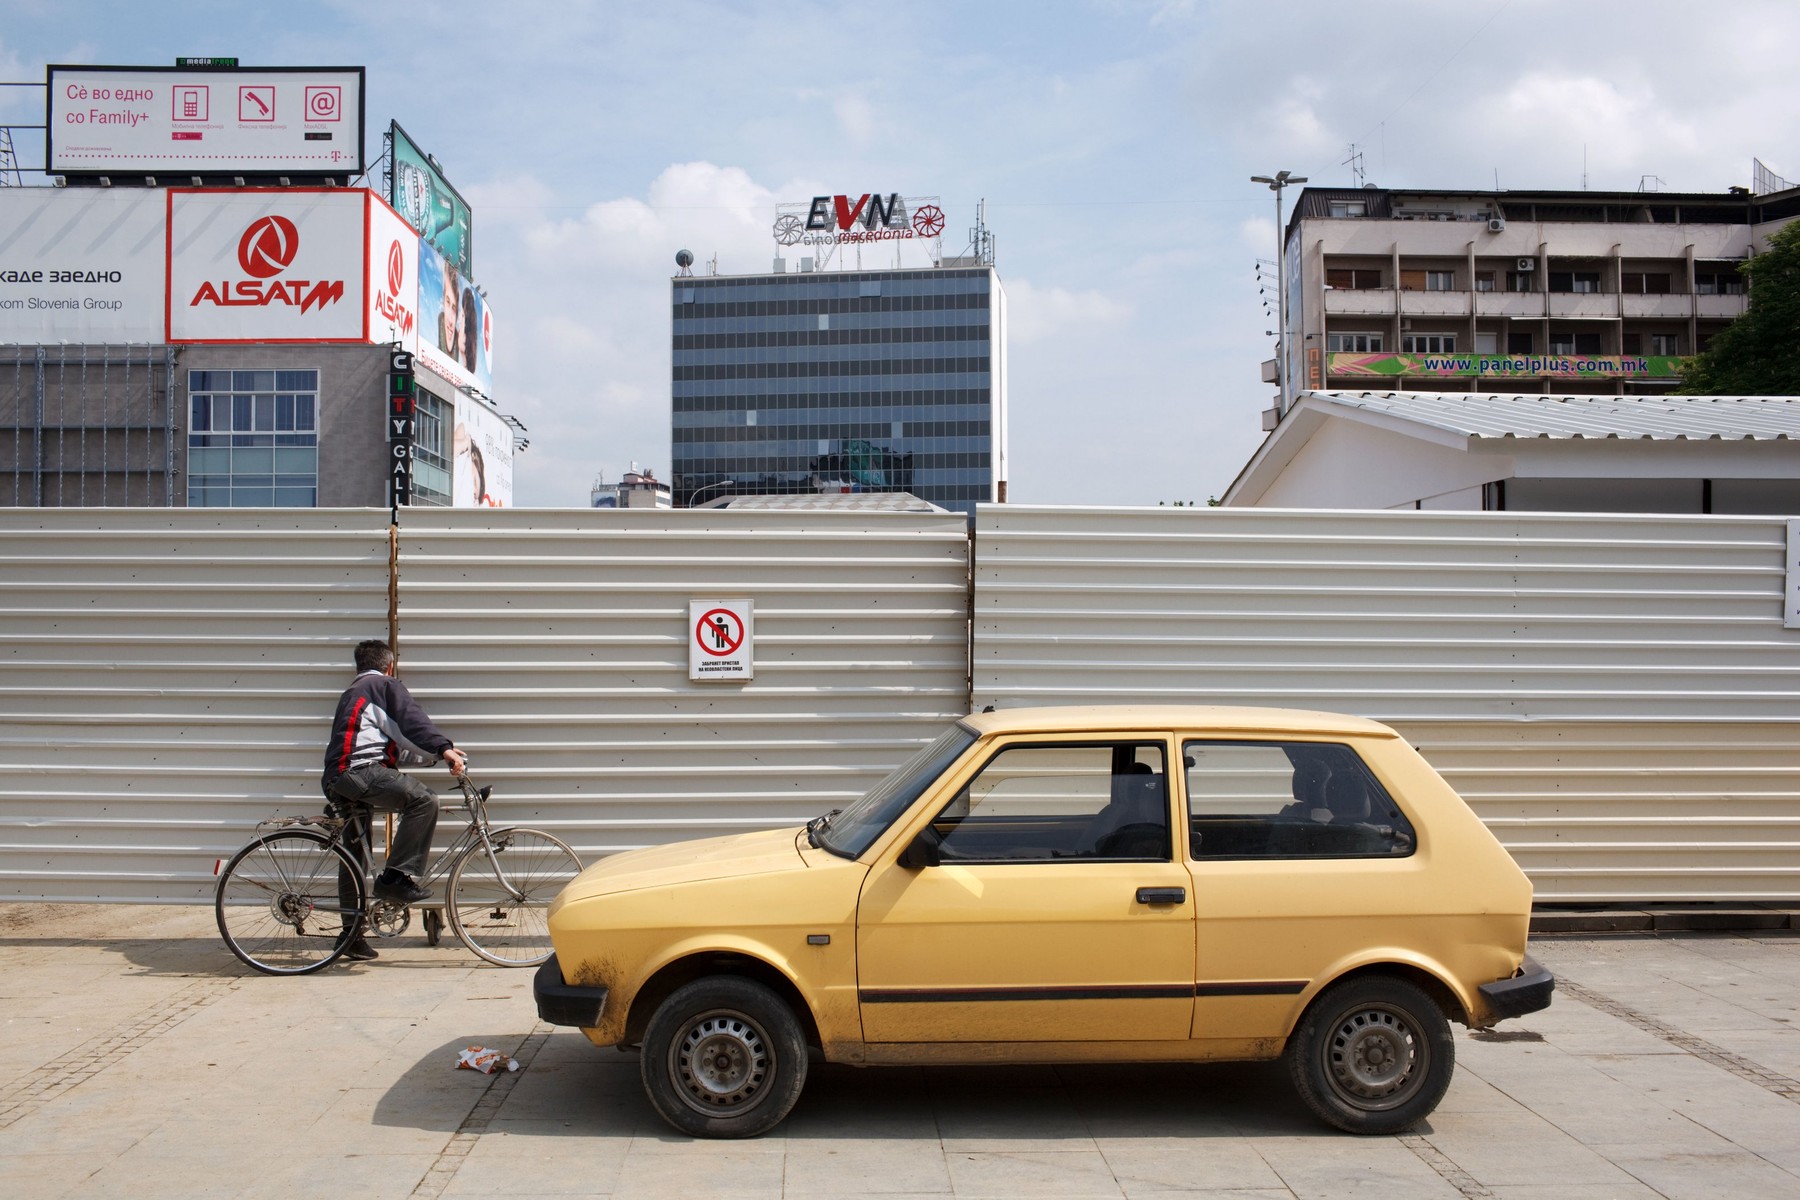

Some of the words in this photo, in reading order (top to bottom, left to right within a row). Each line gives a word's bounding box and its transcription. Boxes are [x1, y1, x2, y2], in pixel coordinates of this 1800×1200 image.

[92, 88, 111, 100] во
[115, 89, 154, 102] едно
[89, 109, 149, 127] Family+
[805, 193, 899, 232] EVN
[838, 226, 913, 242] macedonia
[49, 270, 122, 283] заедно
[28, 297, 80, 310] Slovenia
[83, 297, 123, 312] Group
[1424, 357, 1648, 374] www.panelplus.com.mk
[393, 355, 407, 434] CITY
